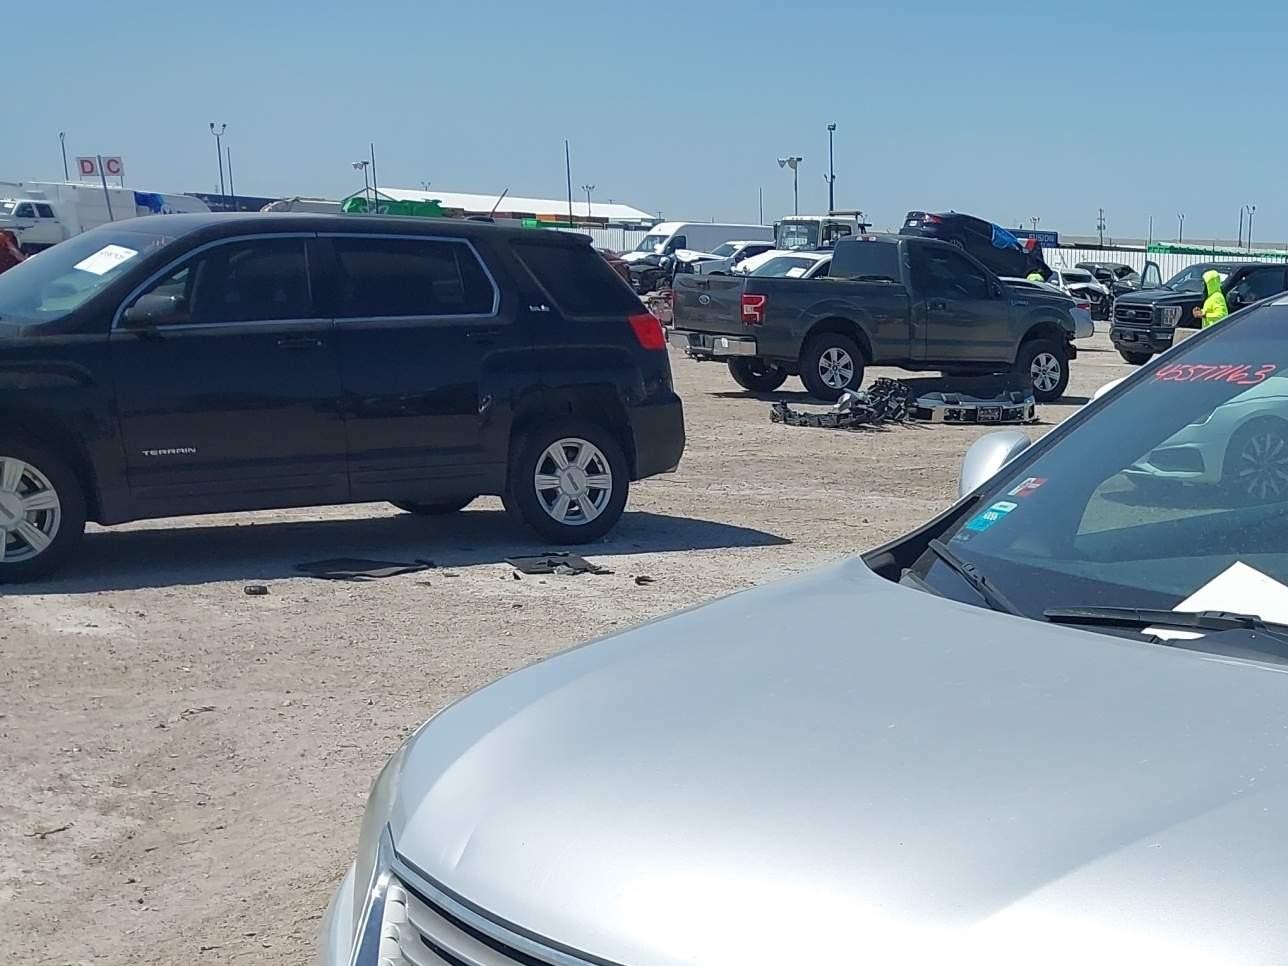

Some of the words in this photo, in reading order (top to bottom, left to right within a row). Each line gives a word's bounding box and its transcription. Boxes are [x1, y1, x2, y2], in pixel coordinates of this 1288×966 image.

[80, 160, 94, 174] D
[107, 159, 121, 174] C
[141, 447, 196, 456] TERRAIN
